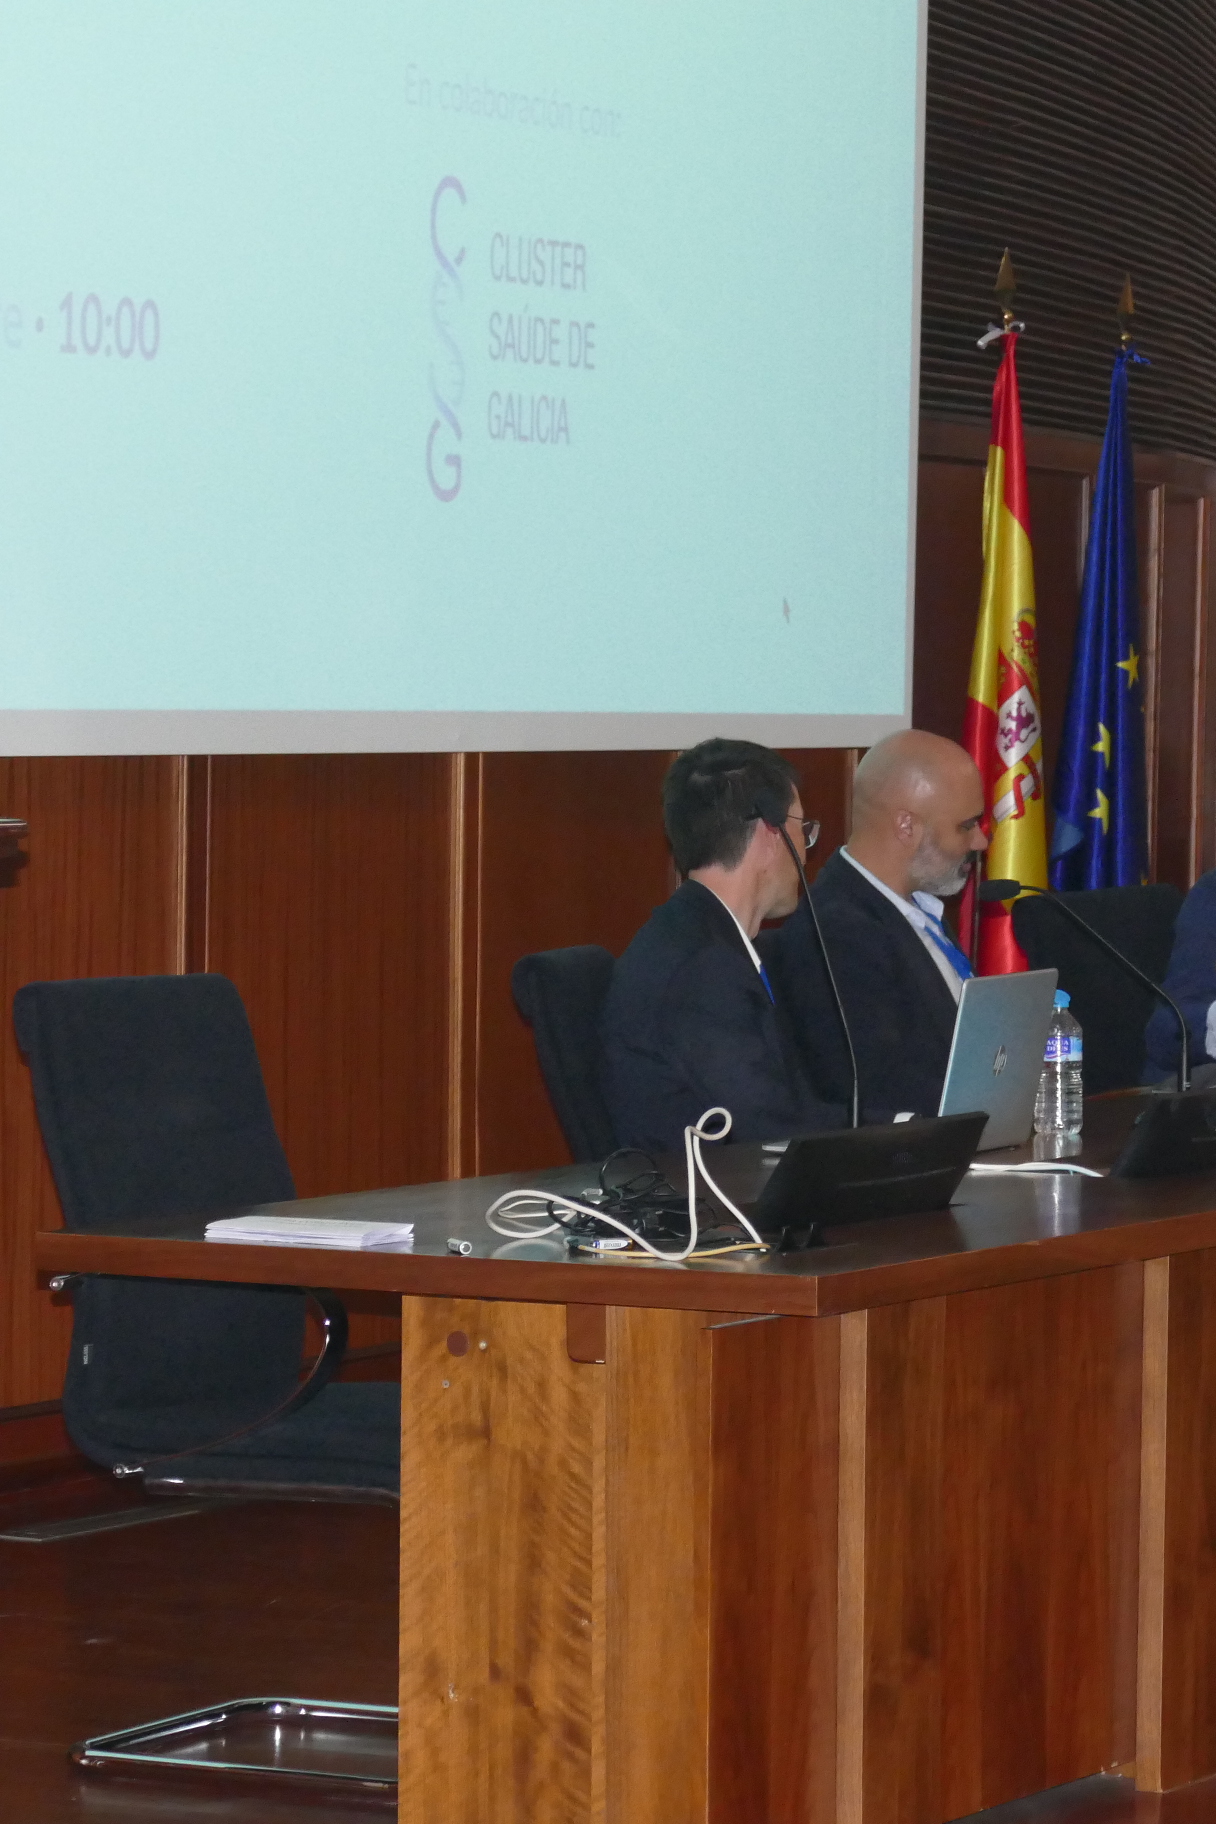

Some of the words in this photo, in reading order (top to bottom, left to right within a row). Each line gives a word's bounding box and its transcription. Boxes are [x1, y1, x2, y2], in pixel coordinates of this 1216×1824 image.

[404, 62, 432, 107] En
[439, 75, 572, 130] colaboración
[488, 231, 589, 292] CLUSTER
[58, 290, 161, 362] 10:00
[487, 302, 561, 368] SAÚDE
[567, 320, 597, 371] DE
[486, 390, 572, 445] GALICIA
